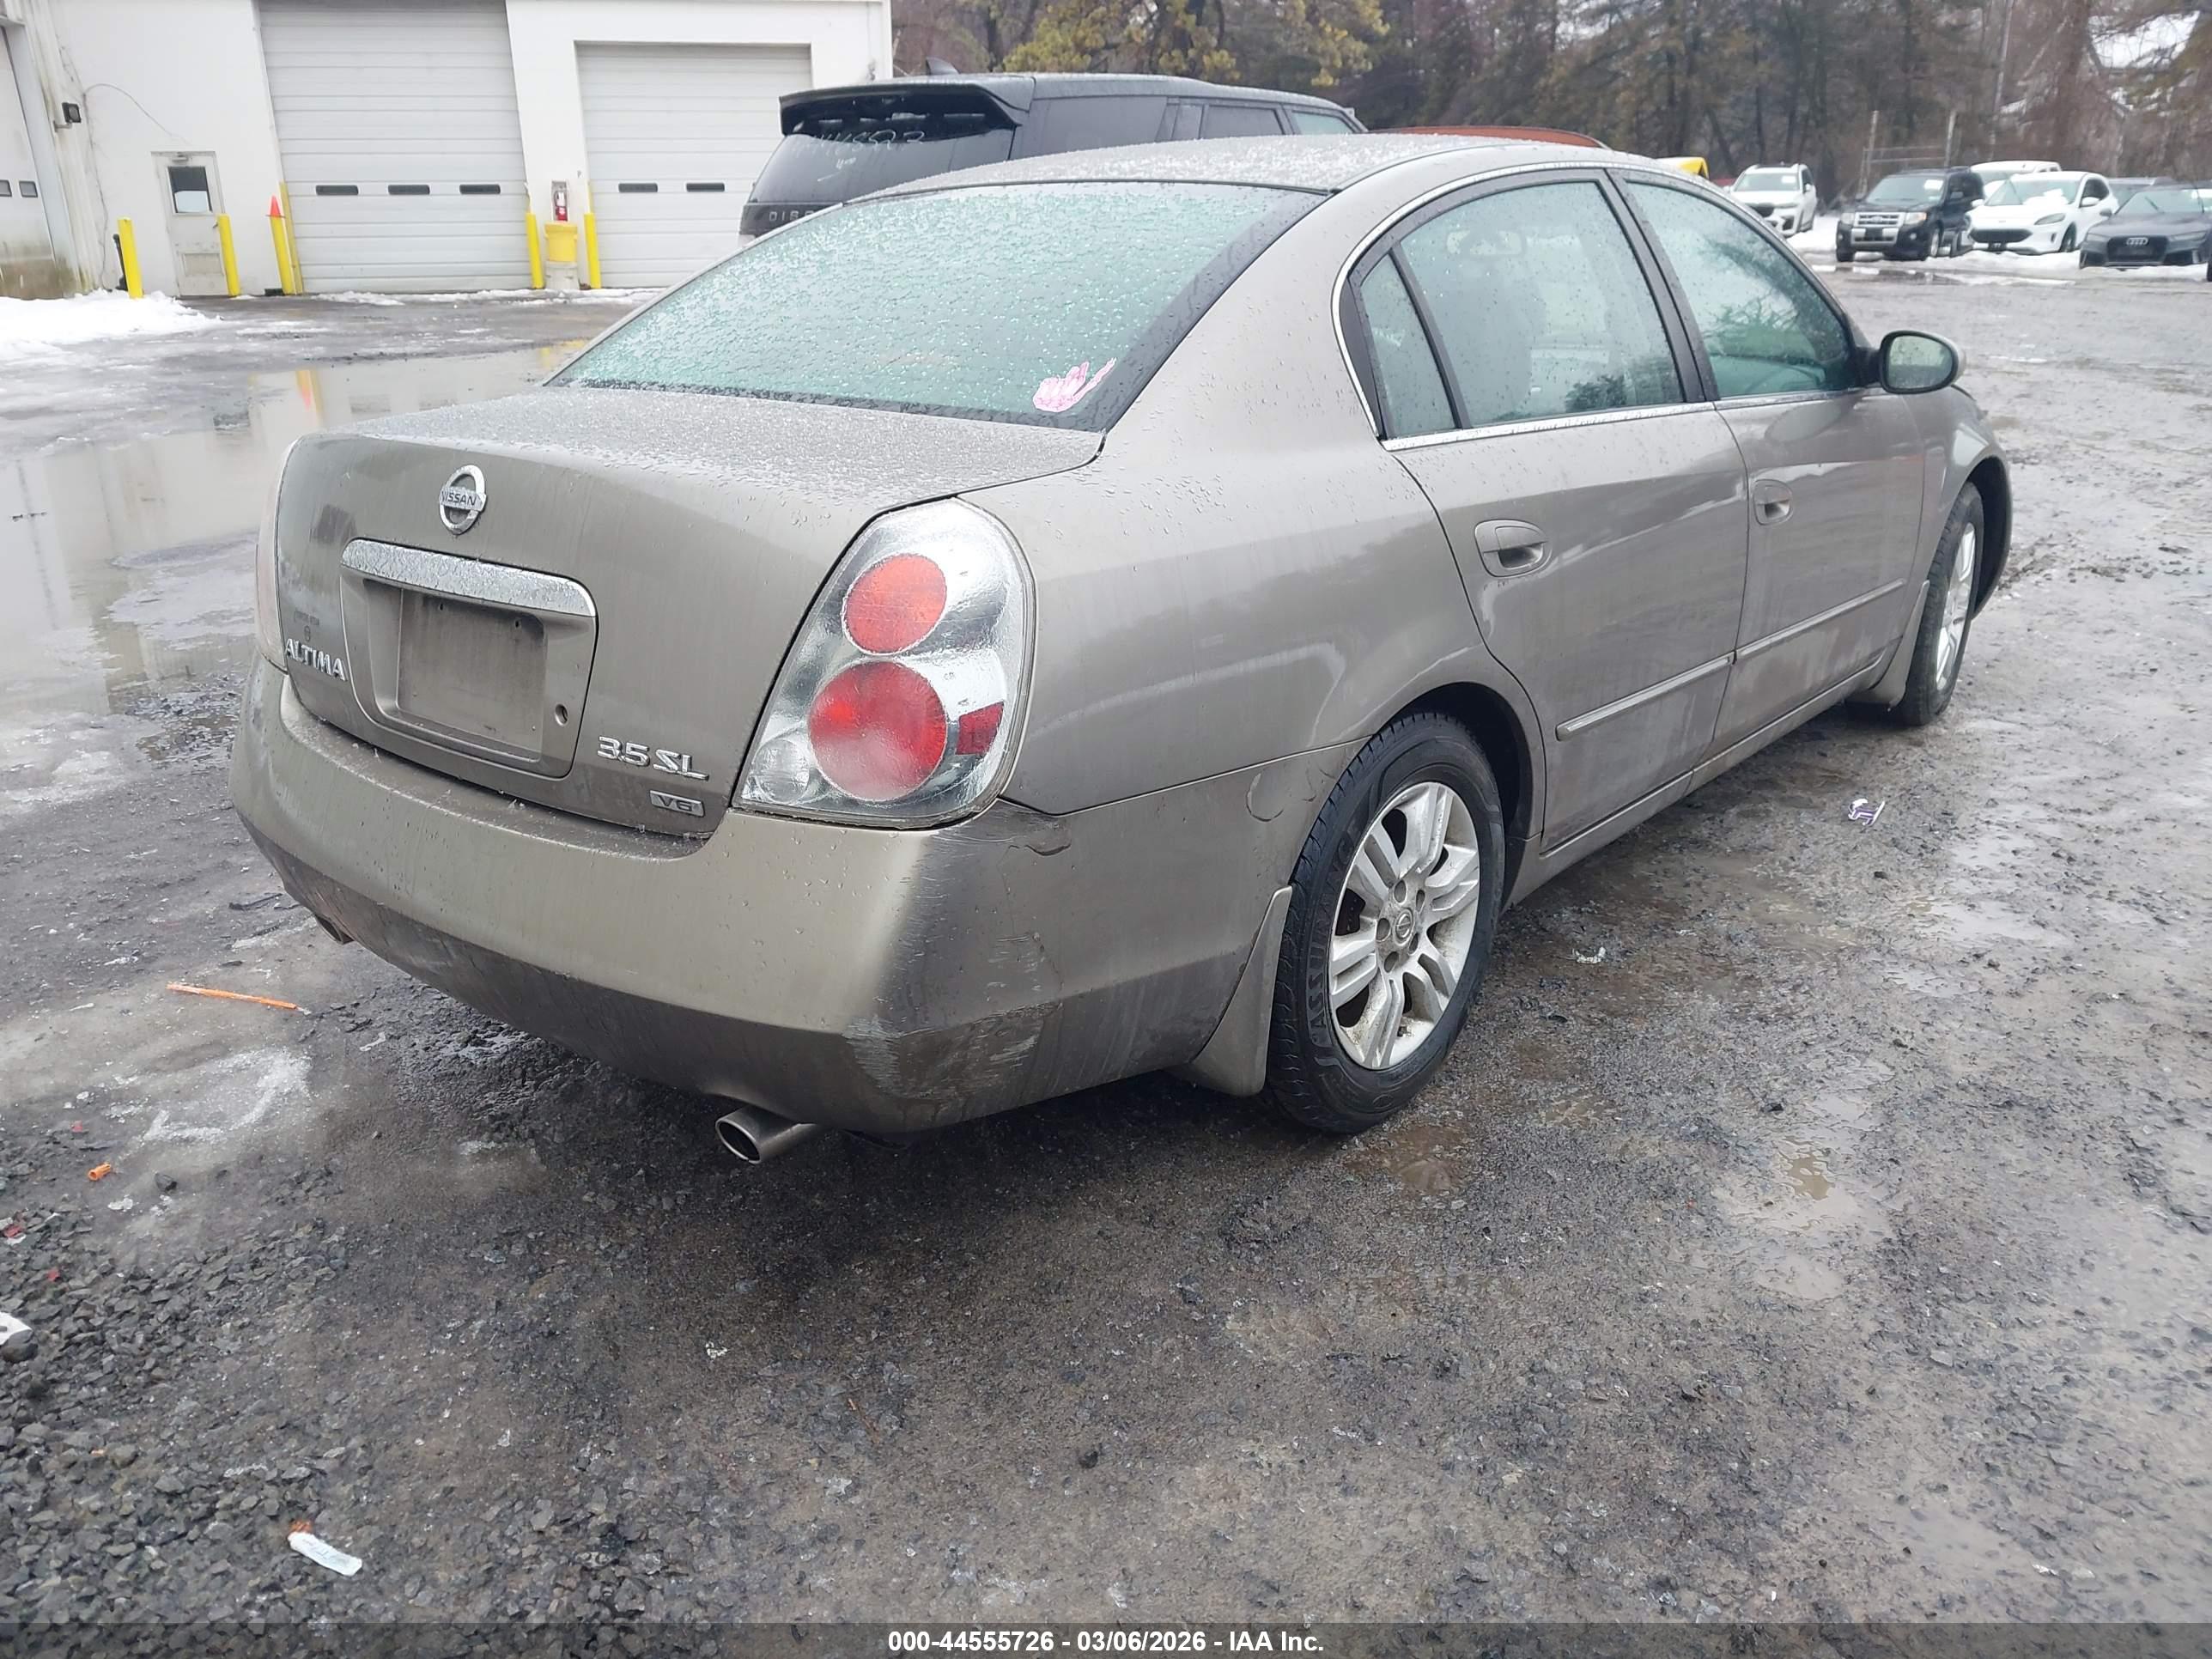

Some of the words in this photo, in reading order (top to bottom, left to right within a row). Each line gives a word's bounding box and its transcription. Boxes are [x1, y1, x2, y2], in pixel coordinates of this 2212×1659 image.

[441, 489, 477, 507] NISSAN
[285, 638, 347, 681] ALTIMA
[653, 749, 709, 781] SL
[654, 793, 696, 813] V6
